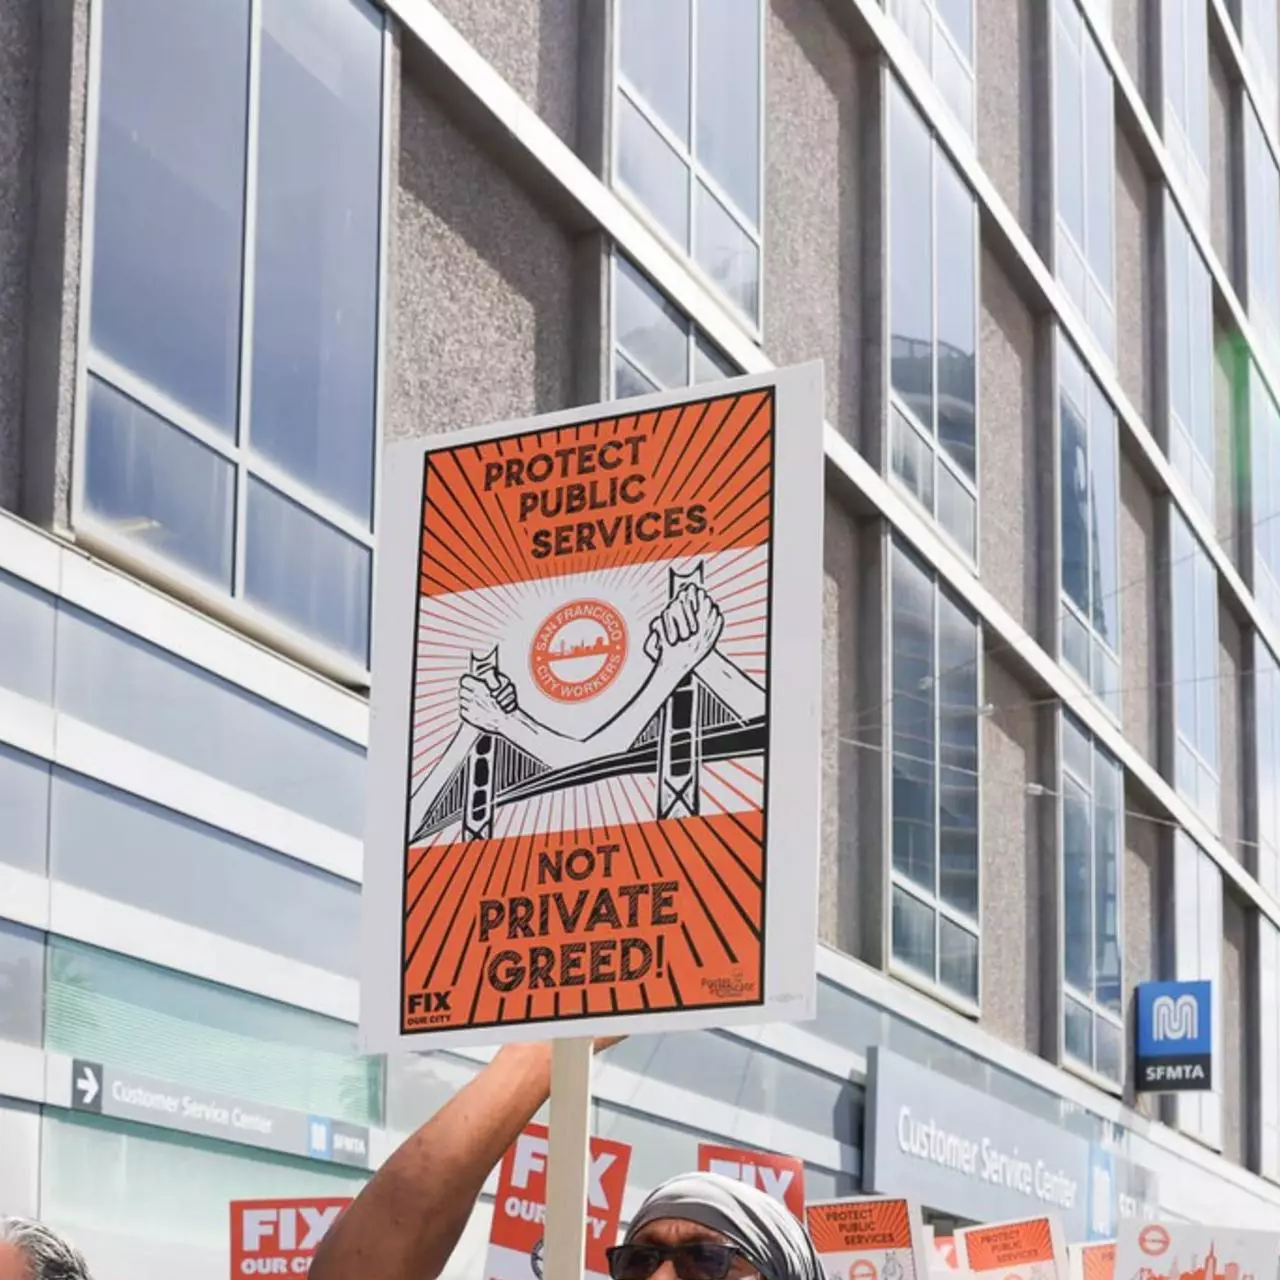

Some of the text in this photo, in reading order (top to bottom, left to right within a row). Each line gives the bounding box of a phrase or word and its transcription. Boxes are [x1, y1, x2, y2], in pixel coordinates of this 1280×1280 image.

[483, 435, 648, 492] PROTECT
[519, 473, 647, 522] PUBLIC
[536, 605, 623, 651] SAN FRANCISCO
[538, 654, 622, 697] CITY WORKERS
[537, 844, 620, 885] NOT
[478, 880, 680, 942] PRIVATE
[487, 934, 665, 992] GREED!
[407, 991, 452, 1014] FIX
[407, 1014, 451, 1026] OUR CITY
[1145, 1064, 1205, 1081] SFMTA
[112, 1080, 273, 1134] Customer Service Center
[510, 1133, 618, 1210] FX
[898, 1104, 979, 1172] Customer
[981, 1136, 1032, 1195] Service
[1034, 1160, 1078, 1208] Center
[825, 1210, 873, 1222] PROTECT
[838, 1221, 876, 1233] PUBLIC
[240, 1257, 288, 1274] OUR
